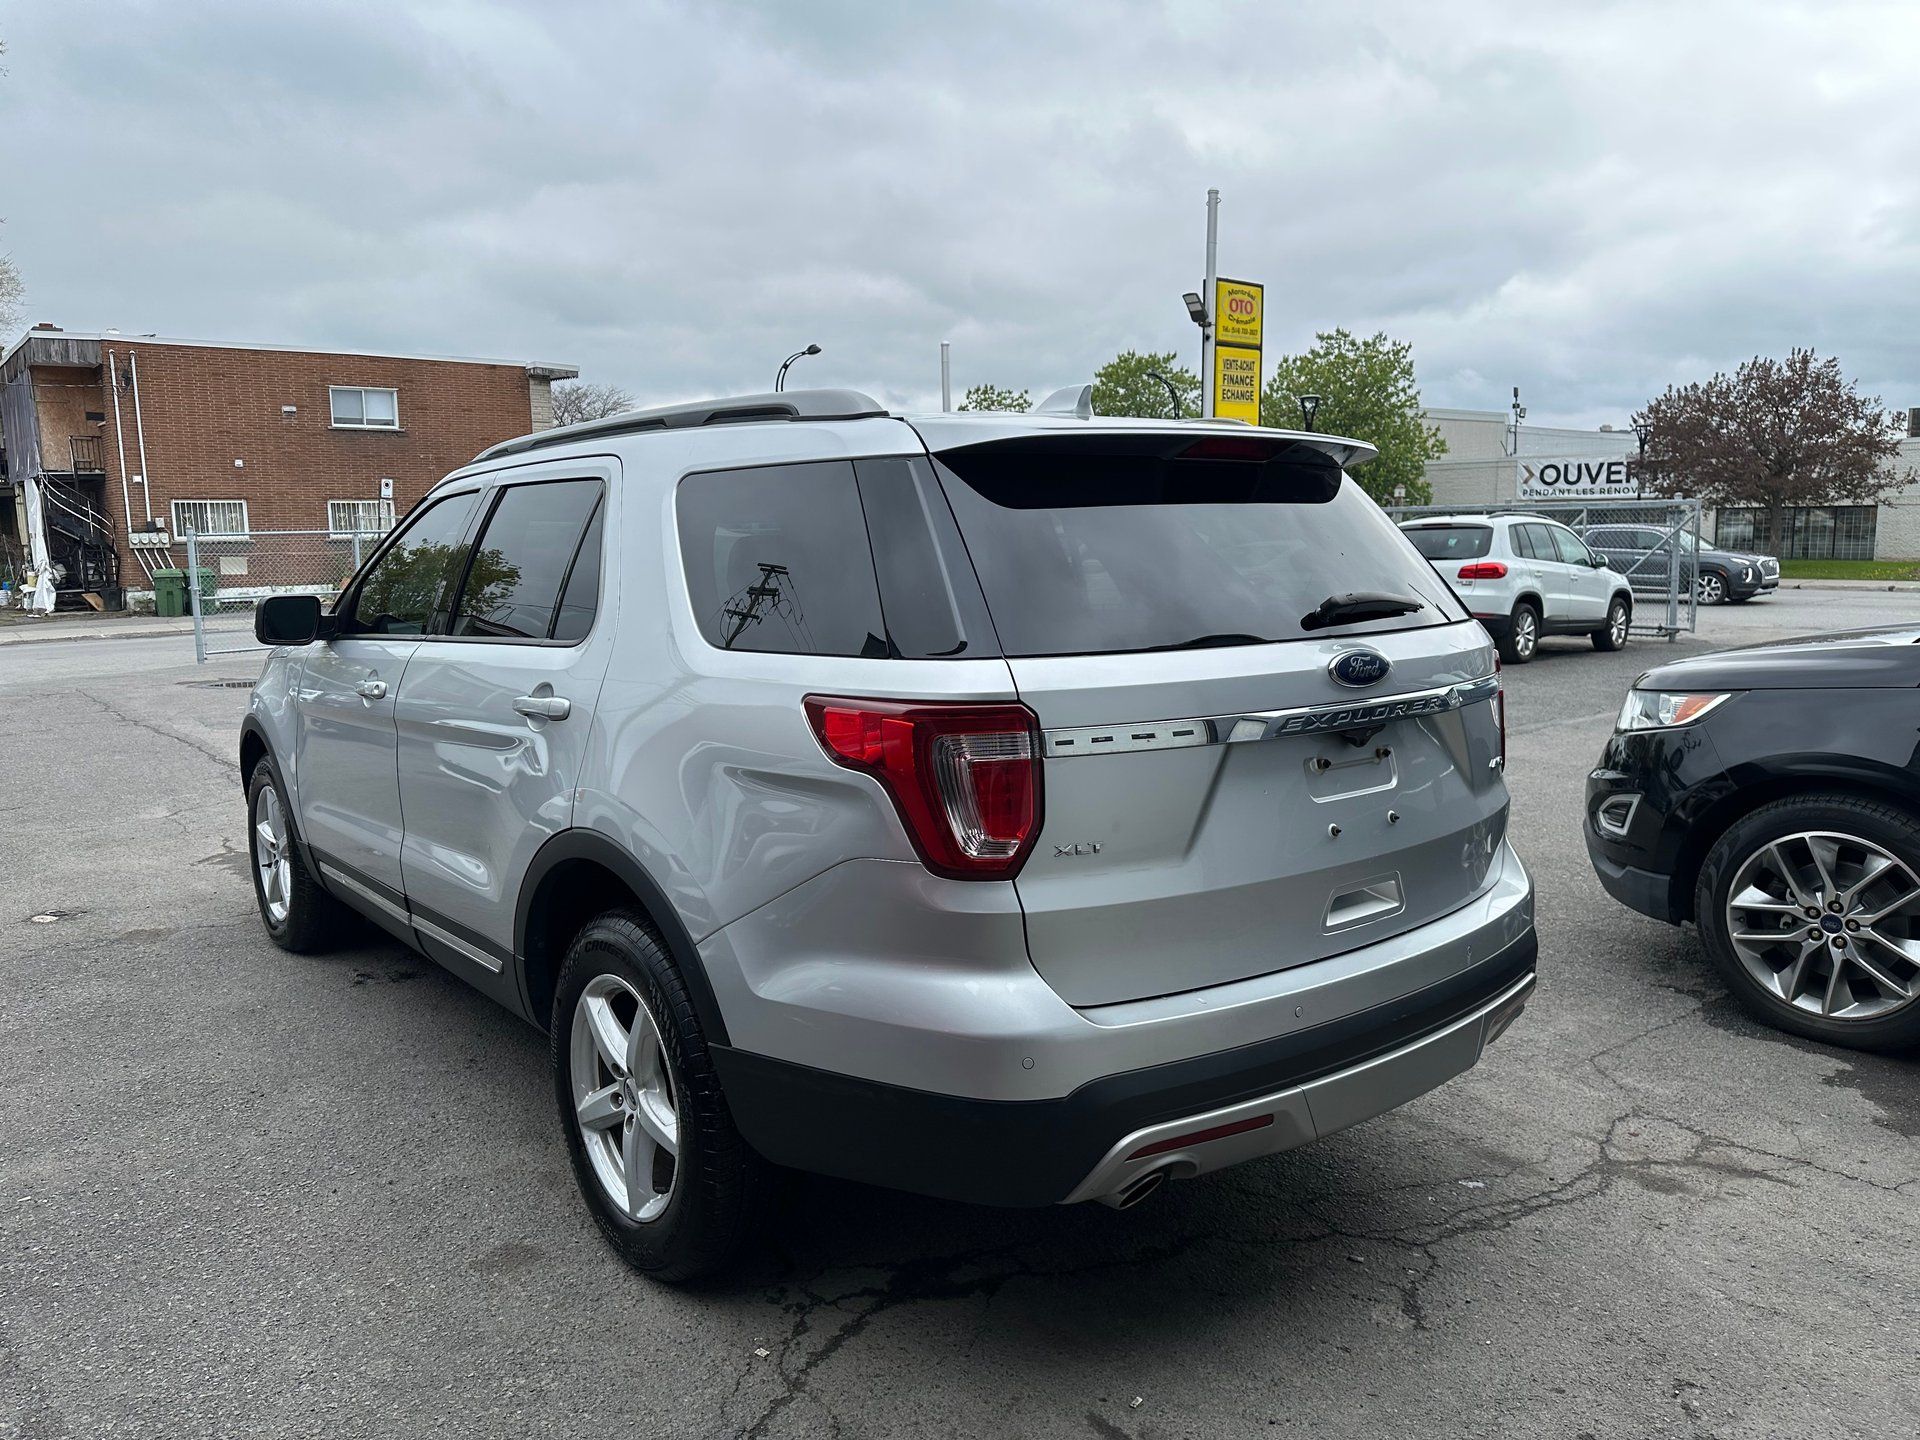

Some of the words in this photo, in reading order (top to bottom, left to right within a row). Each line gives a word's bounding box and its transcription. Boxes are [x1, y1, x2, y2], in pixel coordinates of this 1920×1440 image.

[1229, 298, 1254, 315] OTO
[1222, 358, 1256, 372] VENTE-ACHAT
[1222, 374, 1255, 387] FINANCE
[1222, 388, 1255, 401] ECHANGE
[1539, 461, 1639, 486] OUVER
[1522, 488, 1572, 497] PENDANT
[1576, 488, 1595, 496] LES
[1599, 486, 1639, 496] RÉNOV
[1348, 656, 1381, 679] Ford
[1281, 697, 1444, 733] EXPLORER
[1054, 840, 1103, 858] XLT
